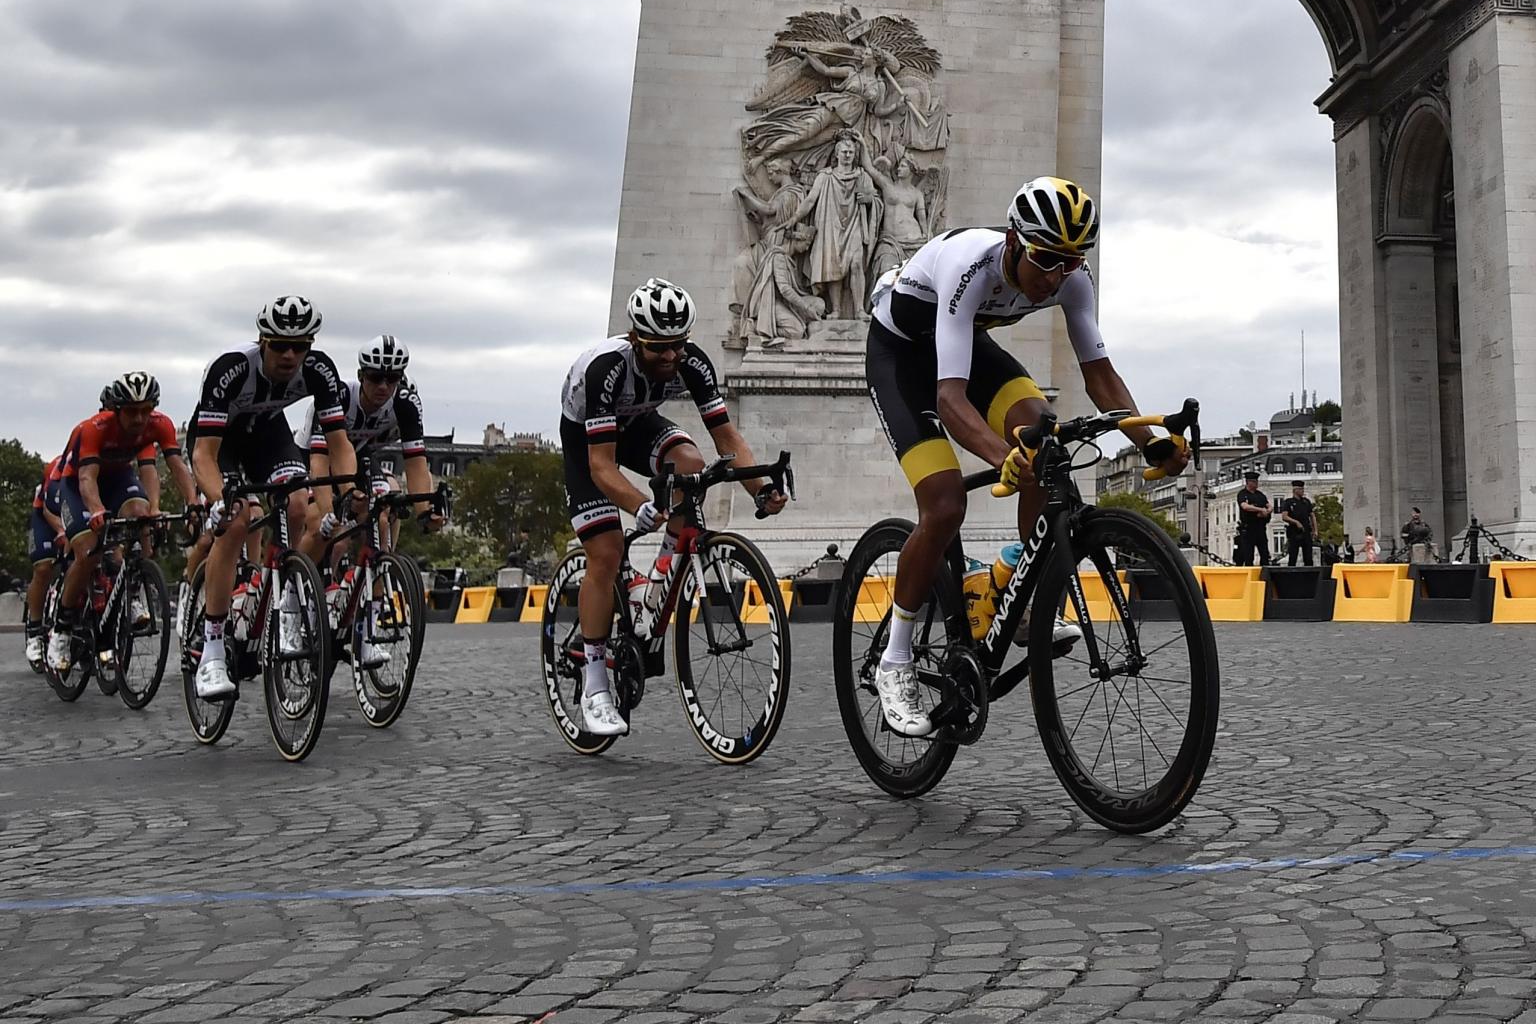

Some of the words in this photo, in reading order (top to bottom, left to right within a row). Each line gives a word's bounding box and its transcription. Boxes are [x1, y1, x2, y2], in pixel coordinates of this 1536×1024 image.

[948, 255, 995, 316] #PassOnPlastic
[219, 361, 248, 390] GIANT
[314, 362, 337, 393] GIANT
[603, 360, 625, 393] GIANT
[687, 356, 715, 388] GIANT
[577, 497, 612, 511] SAMSU
[548, 552, 587, 614] GIANT
[985, 514, 1048, 653] PINARELLO
[1070, 574, 1089, 625] PINARELLO
[353, 659, 377, 719] GIANT
[764, 602, 781, 727] GIANT
[544, 654, 580, 741] GIANT
[680, 681, 736, 755] GIANT
